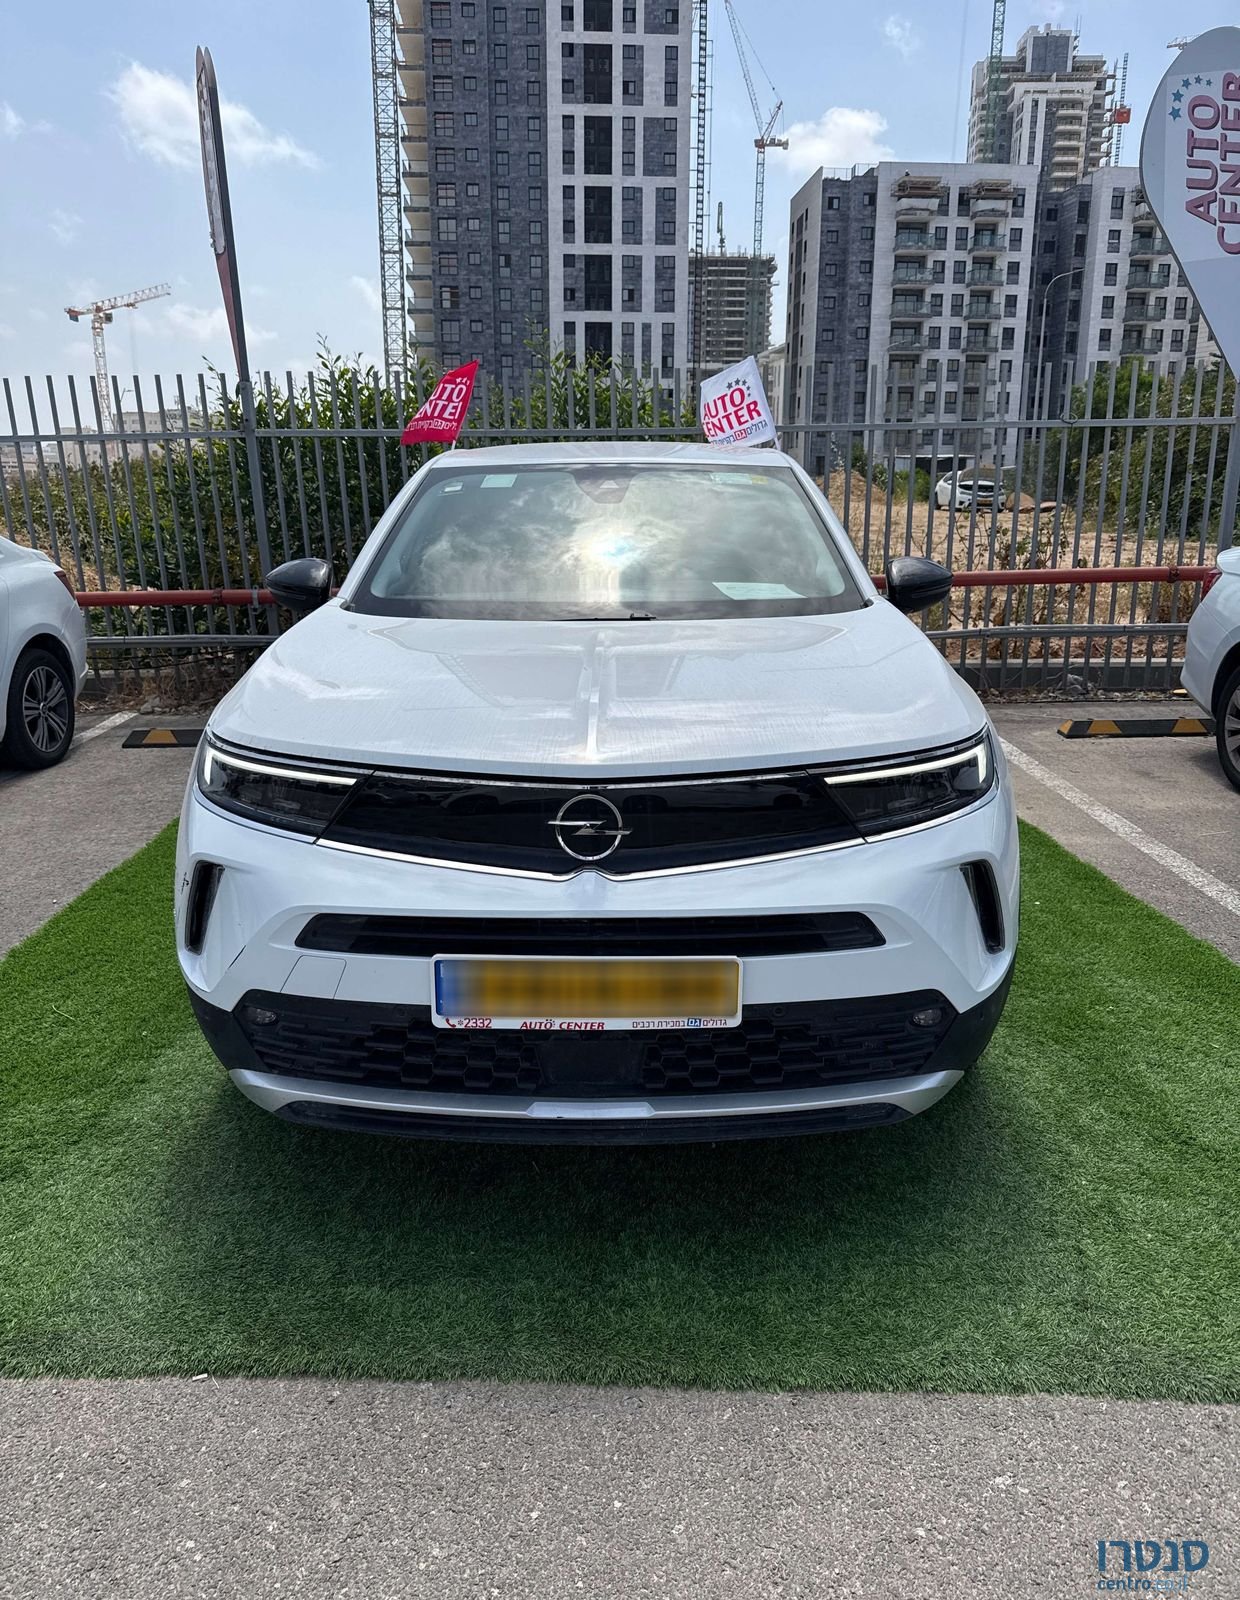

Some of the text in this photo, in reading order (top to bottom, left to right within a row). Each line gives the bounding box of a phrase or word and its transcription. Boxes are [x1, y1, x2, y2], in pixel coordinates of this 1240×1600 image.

[1185, 94, 1221, 226] AUTO
[1217, 71, 1240, 256] CENTER
[430, 383, 467, 402] UTO
[702, 400, 762, 438] ENTER
[746, 419, 769, 436] גדולים
[734, 428, 747, 440] גם
[520, 1021, 605, 1030] AUTO CENTER
[632, 1018, 727, 1029] גדולים גם במכירת רכבים
